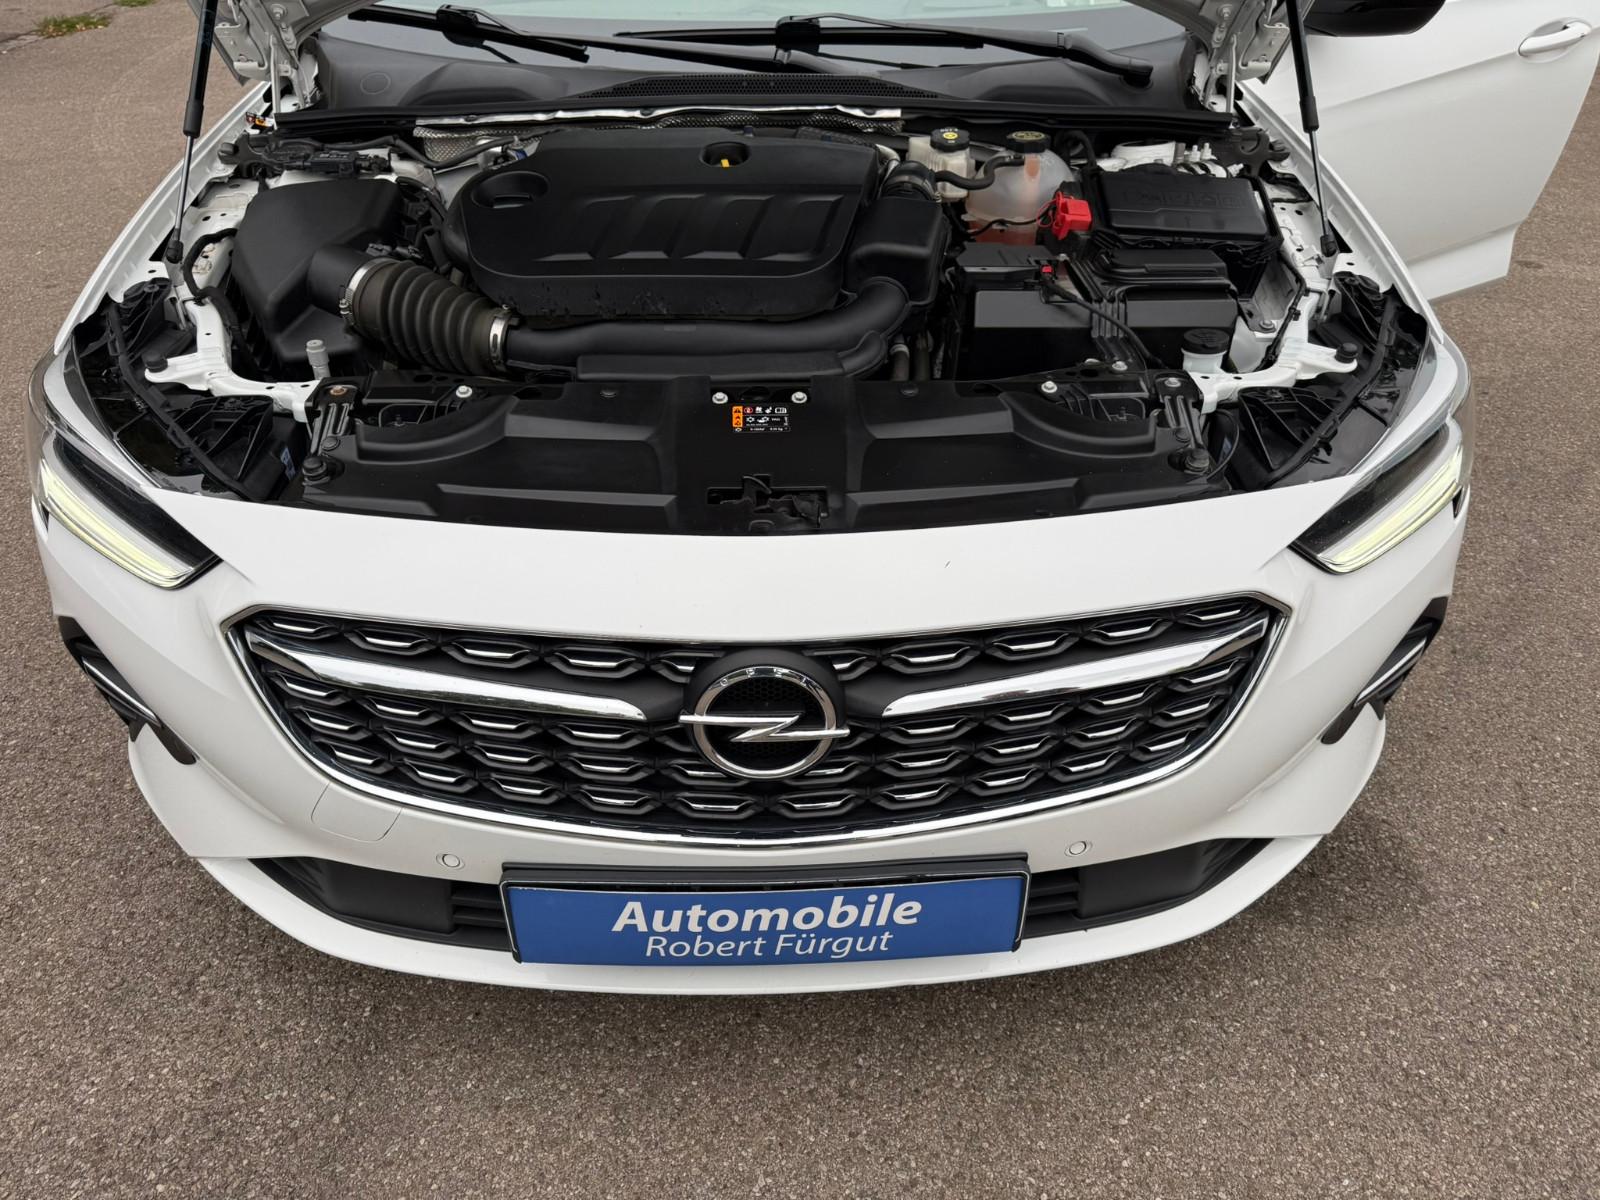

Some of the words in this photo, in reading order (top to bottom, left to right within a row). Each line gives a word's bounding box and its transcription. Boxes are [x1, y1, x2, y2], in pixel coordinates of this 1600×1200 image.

[612, 893, 922, 933] Automobile
[646, 935, 767, 957] Robert
[774, 931, 894, 959] Fürgut
